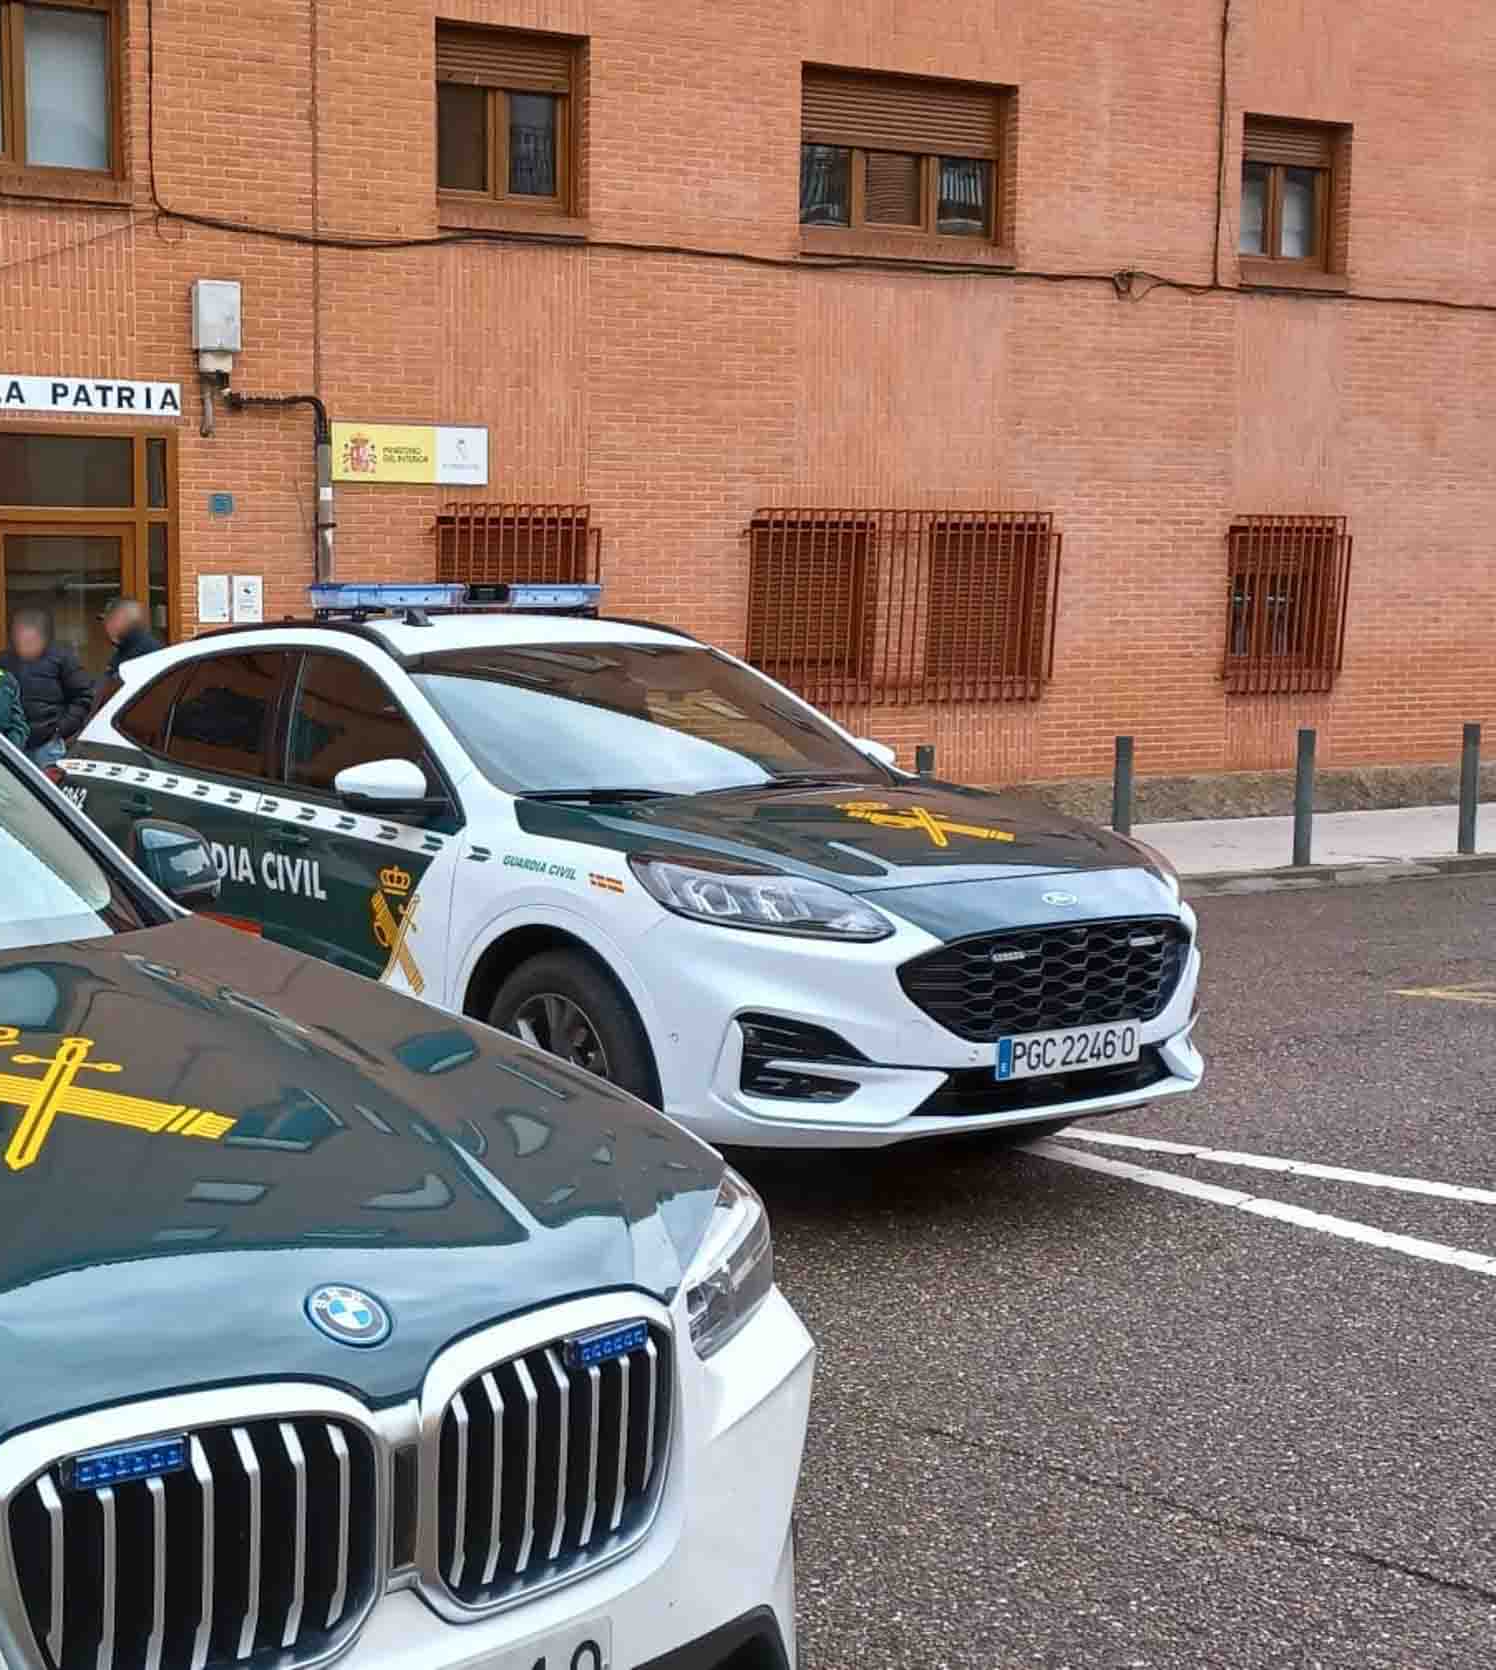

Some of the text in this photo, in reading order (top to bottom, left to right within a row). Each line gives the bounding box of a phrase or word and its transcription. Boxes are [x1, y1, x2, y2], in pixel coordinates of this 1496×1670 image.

[51, 384, 180, 411] PATRIA
[261, 850, 328, 901] CIVIL
[502, 854, 577, 881] GUARDIA CIVIL
[1012, 1037, 1057, 1073] PGC
[1060, 1028, 1117, 1067] 2246
